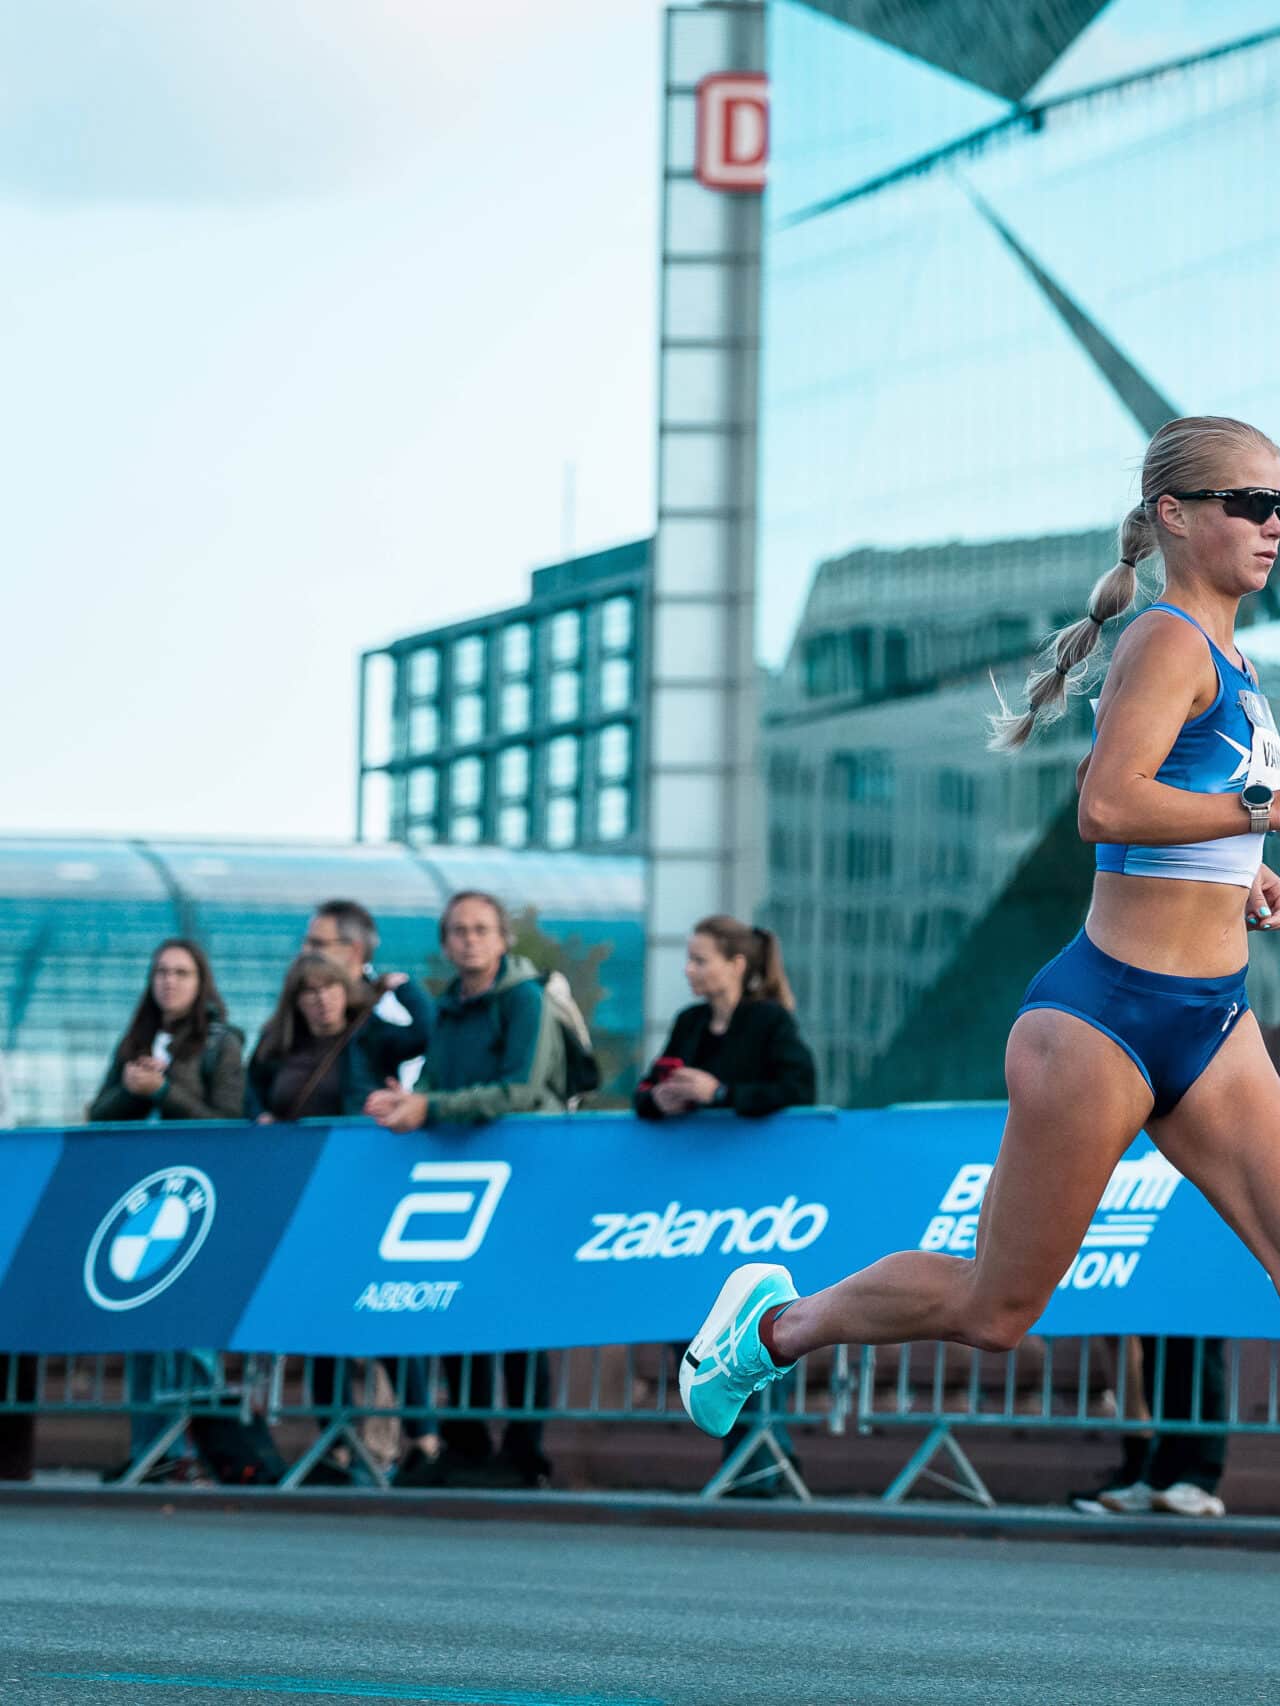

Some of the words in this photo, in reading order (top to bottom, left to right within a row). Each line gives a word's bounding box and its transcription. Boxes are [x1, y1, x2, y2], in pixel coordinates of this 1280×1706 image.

[126, 1175, 208, 1216] BMW
[574, 1195, 830, 1262] zalando
[353, 1280, 464, 1312] ABBOTT
